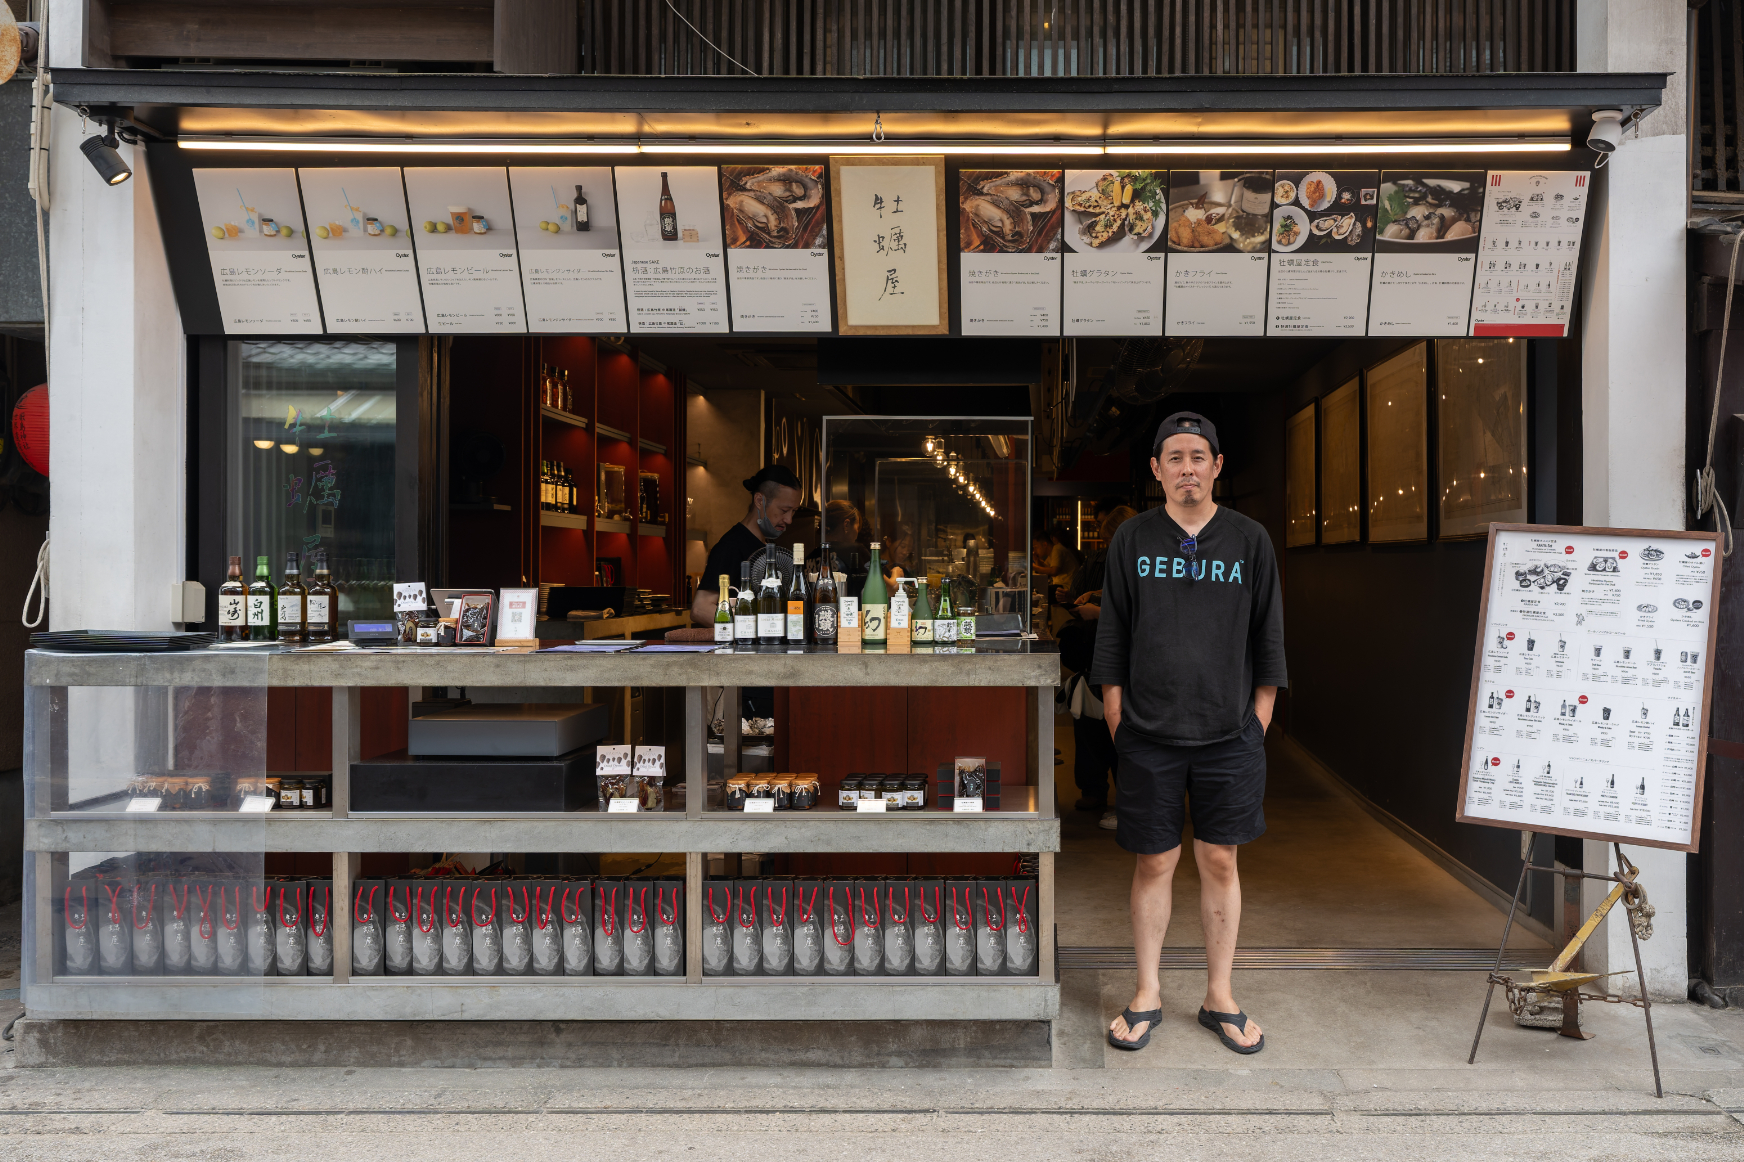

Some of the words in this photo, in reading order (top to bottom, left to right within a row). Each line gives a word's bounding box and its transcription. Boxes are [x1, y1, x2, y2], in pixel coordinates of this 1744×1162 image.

[872, 193, 907, 301] 牡蠣屋
[220, 267, 282, 276] 広島レモンソーダ
[426, 266, 490, 275] 広島レモンビール
[1071, 269, 1118, 278] 牡蠣グラタン
[1174, 269, 1213, 278] かきフライ
[1137, 556, 1242, 584] GEBURA
[252, 598, 264, 622] 白州
